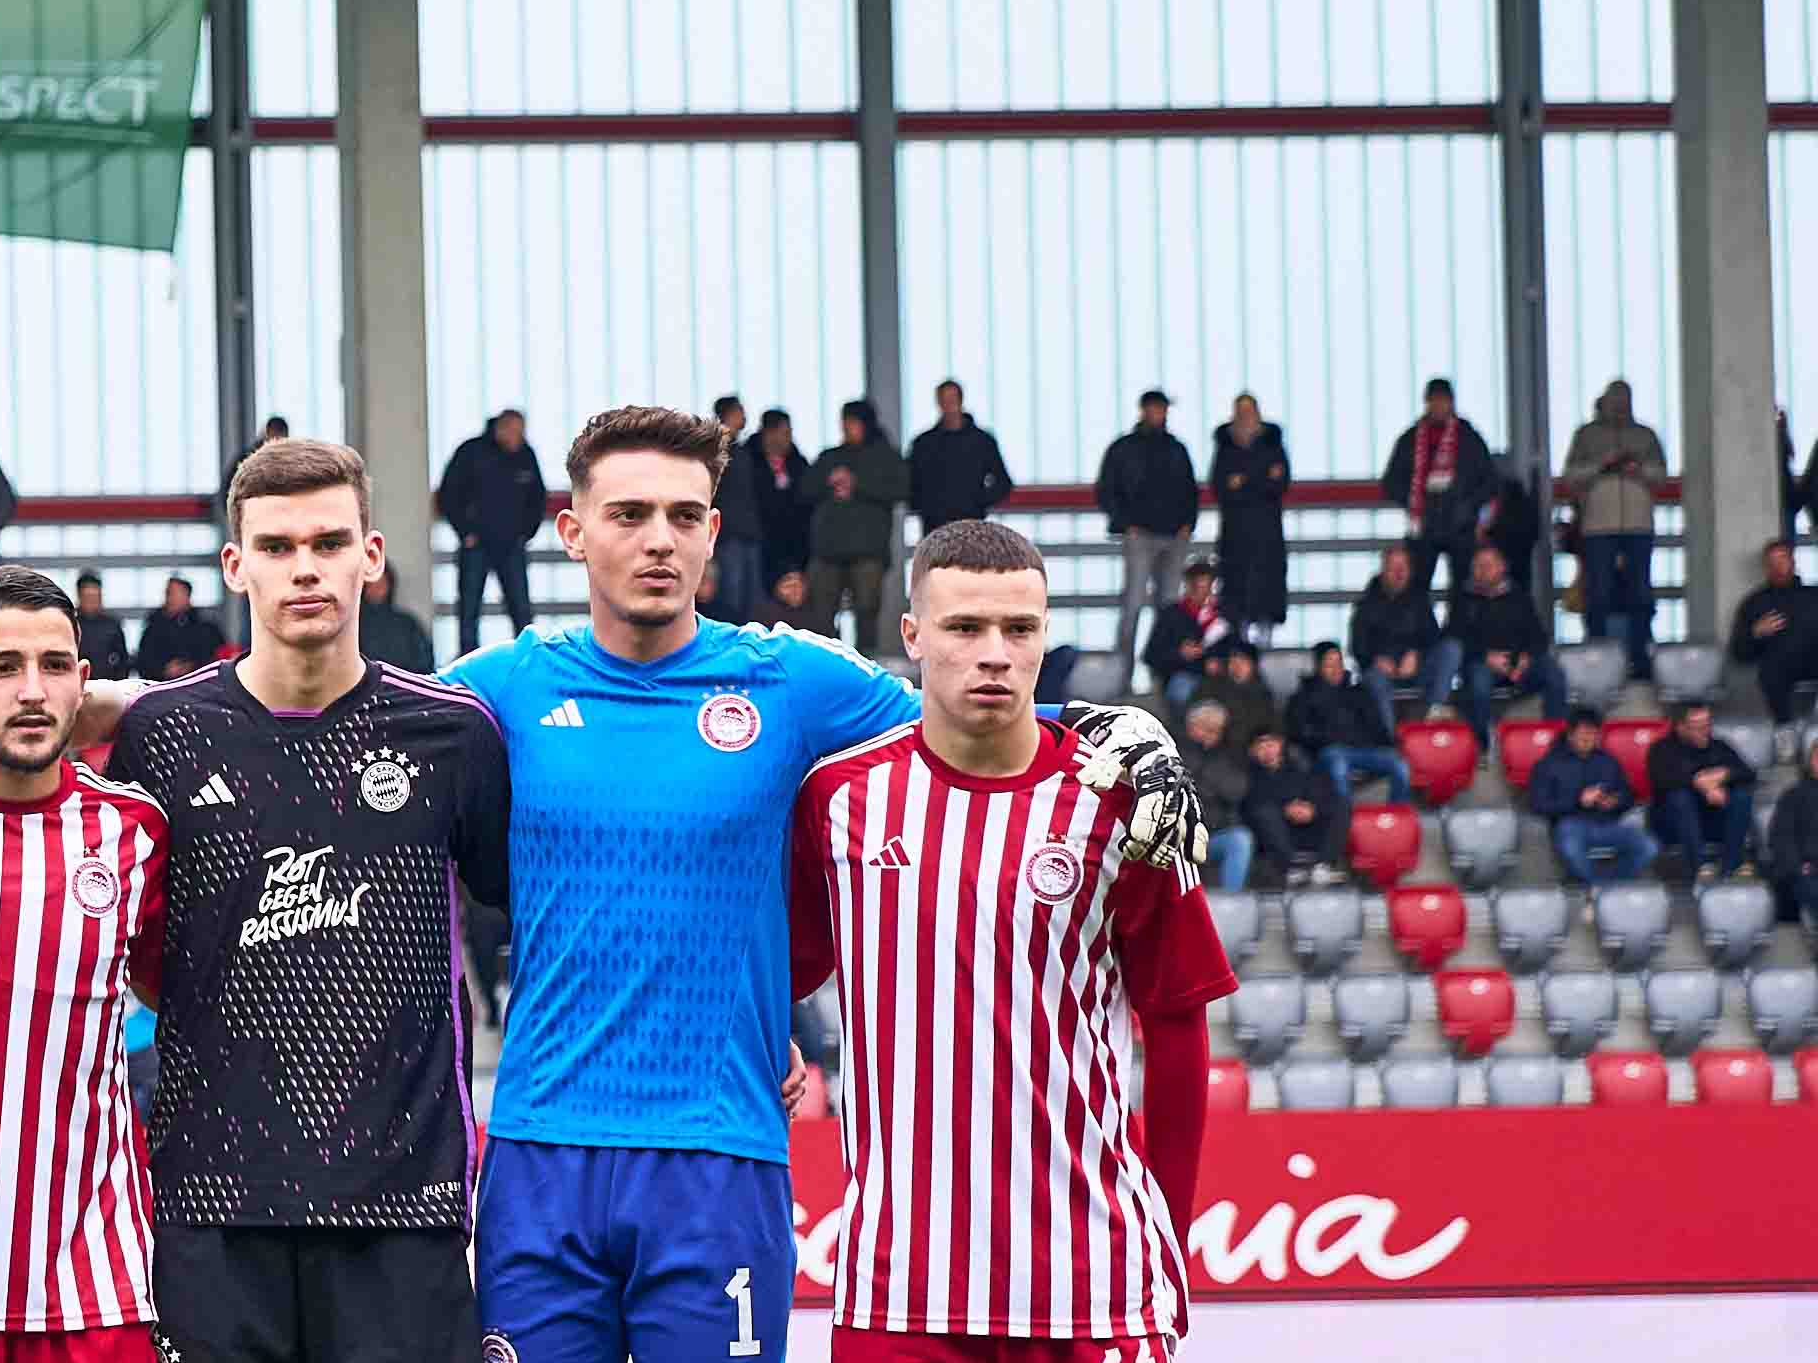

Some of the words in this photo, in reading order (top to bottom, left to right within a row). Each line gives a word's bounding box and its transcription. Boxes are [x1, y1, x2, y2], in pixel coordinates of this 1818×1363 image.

[259, 864, 324, 909] GEGEN
[262, 844, 334, 889] ROT
[239, 882, 370, 948] RASSISMUS
[725, 1268, 761, 1356] 1
